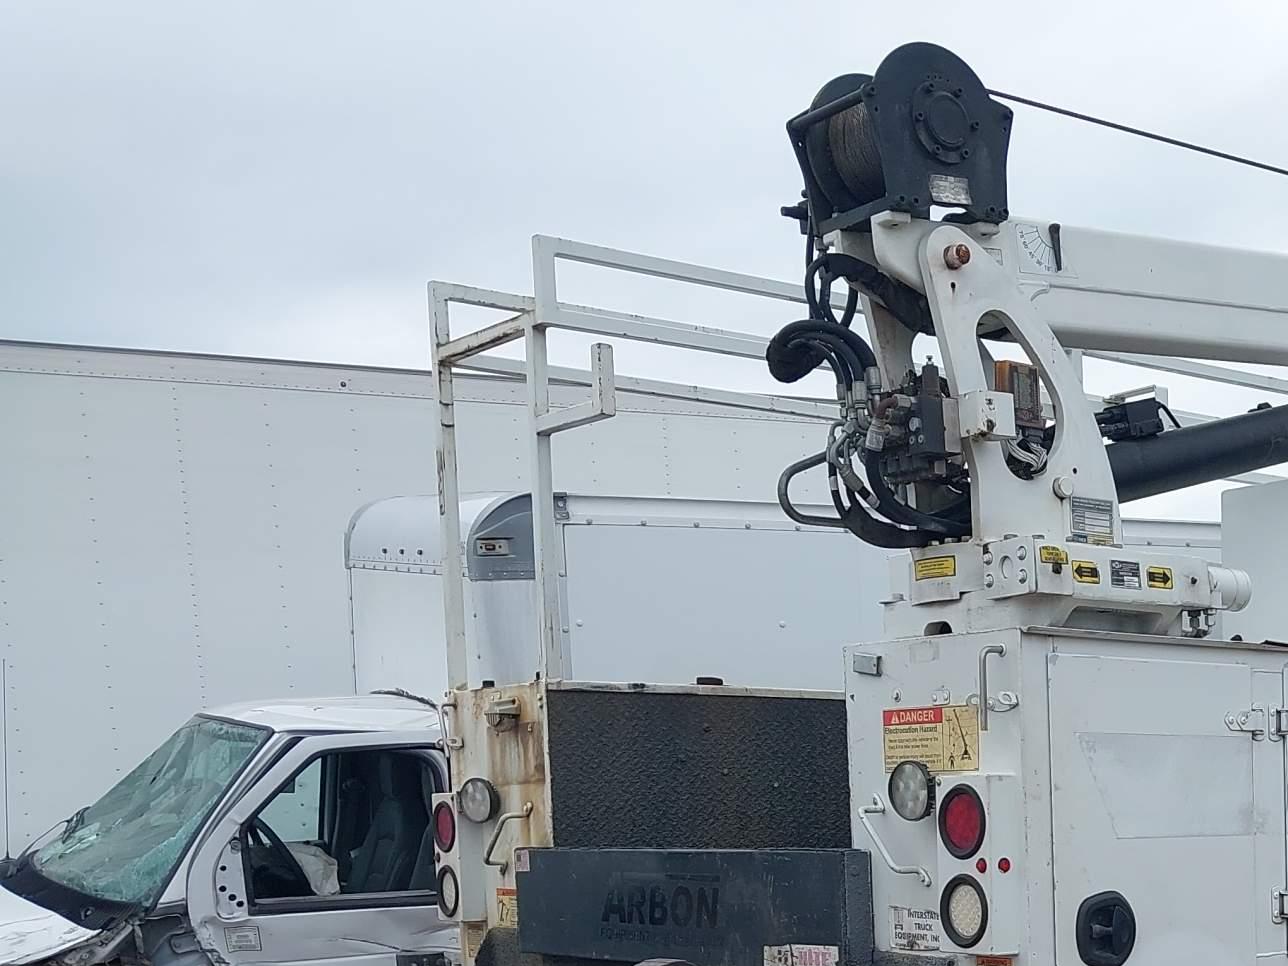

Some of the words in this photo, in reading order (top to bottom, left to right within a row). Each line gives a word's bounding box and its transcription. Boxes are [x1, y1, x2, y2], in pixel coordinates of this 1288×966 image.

[900, 709, 935, 723] DANGER
[601, 885, 720, 929] ARBON
[907, 908, 940, 921] INTERSTATE
[914, 922, 933, 931] TRUCK
